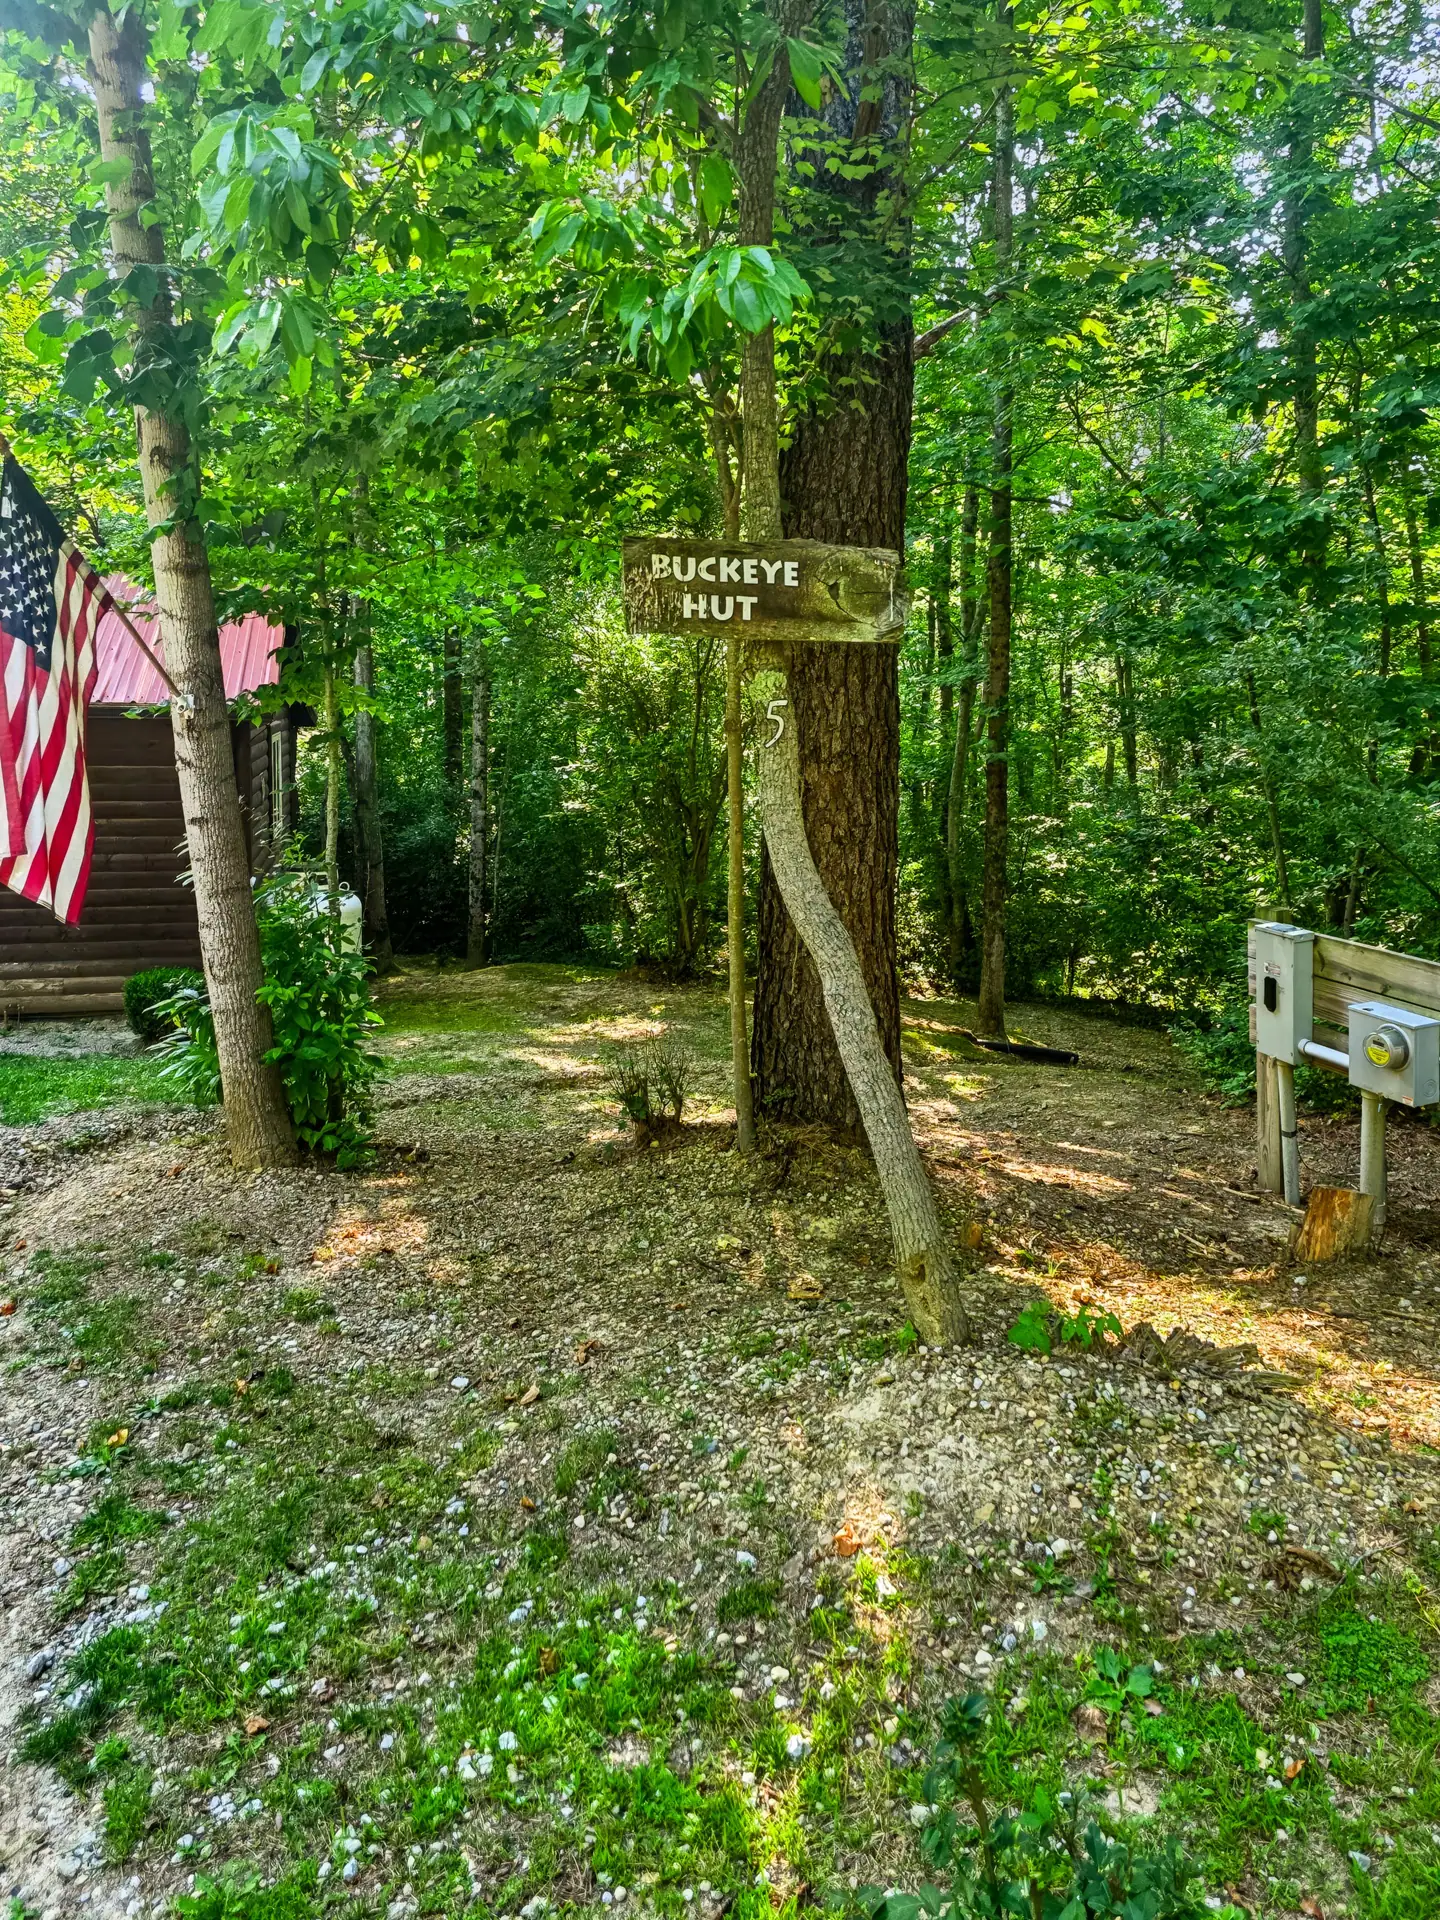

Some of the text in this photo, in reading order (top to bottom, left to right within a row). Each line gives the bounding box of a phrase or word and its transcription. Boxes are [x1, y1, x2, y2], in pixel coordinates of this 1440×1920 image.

[651, 553, 799, 587] BUCKEYE
[683, 593, 758, 621] HUT
[765, 700, 788, 748] 5
